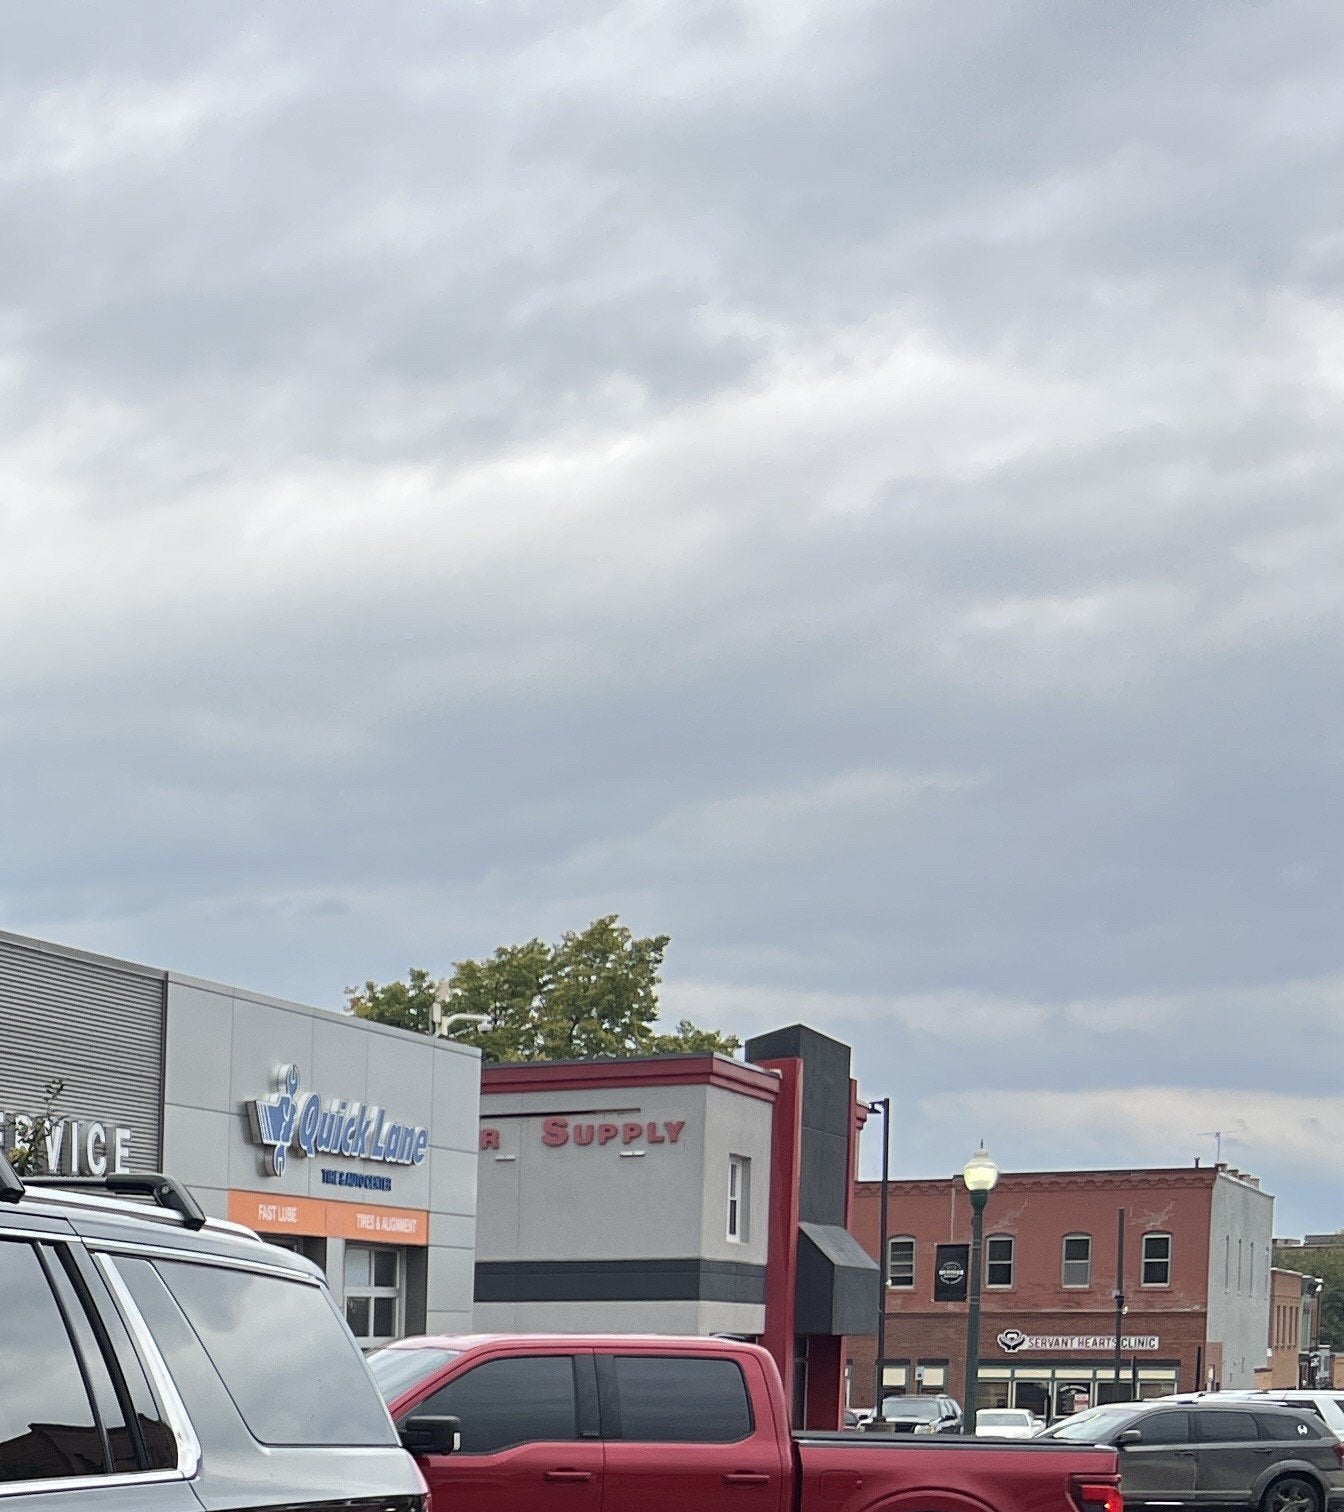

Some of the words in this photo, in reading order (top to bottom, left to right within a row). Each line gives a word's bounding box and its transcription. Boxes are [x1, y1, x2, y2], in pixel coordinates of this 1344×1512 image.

[298, 1091, 372, 1159] Quick
[369, 1106, 430, 1167] Lane
[258, 1204, 278, 1223] FAST
[277, 1205, 298, 1224] LUBE
[356, 1213, 375, 1231] TIRES
[1028, 1336, 1075, 1349] SERVANT
[1077, 1336, 1117, 1349] HEARTS
[1120, 1336, 1156, 1349] CLINIC
